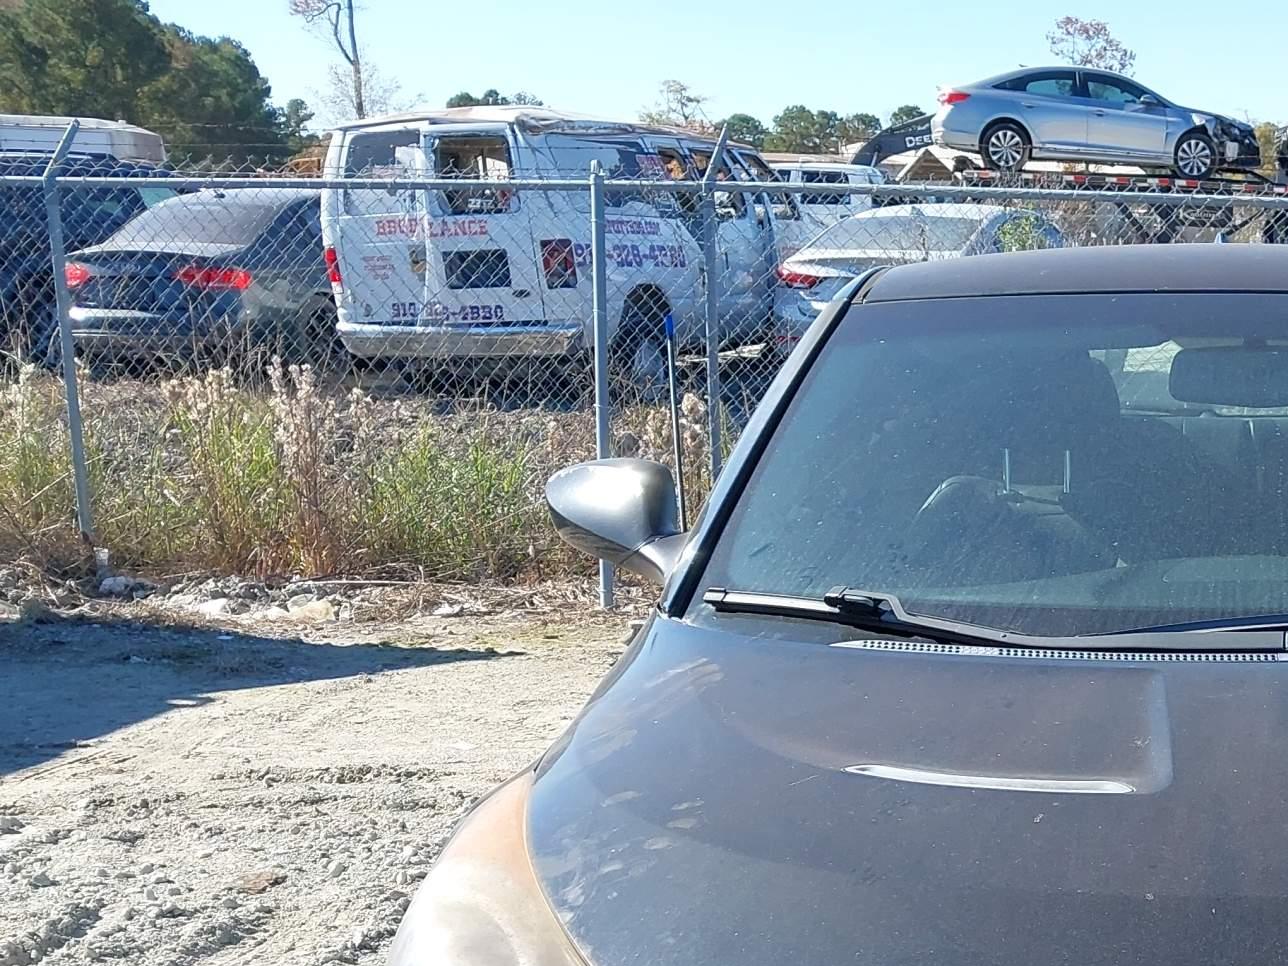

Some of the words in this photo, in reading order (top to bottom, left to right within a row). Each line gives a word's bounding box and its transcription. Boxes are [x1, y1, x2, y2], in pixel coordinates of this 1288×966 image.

[375, 217, 489, 237] BBQBLANCE
[573, 243, 687, 268] 91-328-4BBQ
[391, 302, 505, 321] 910328-4BBQ
